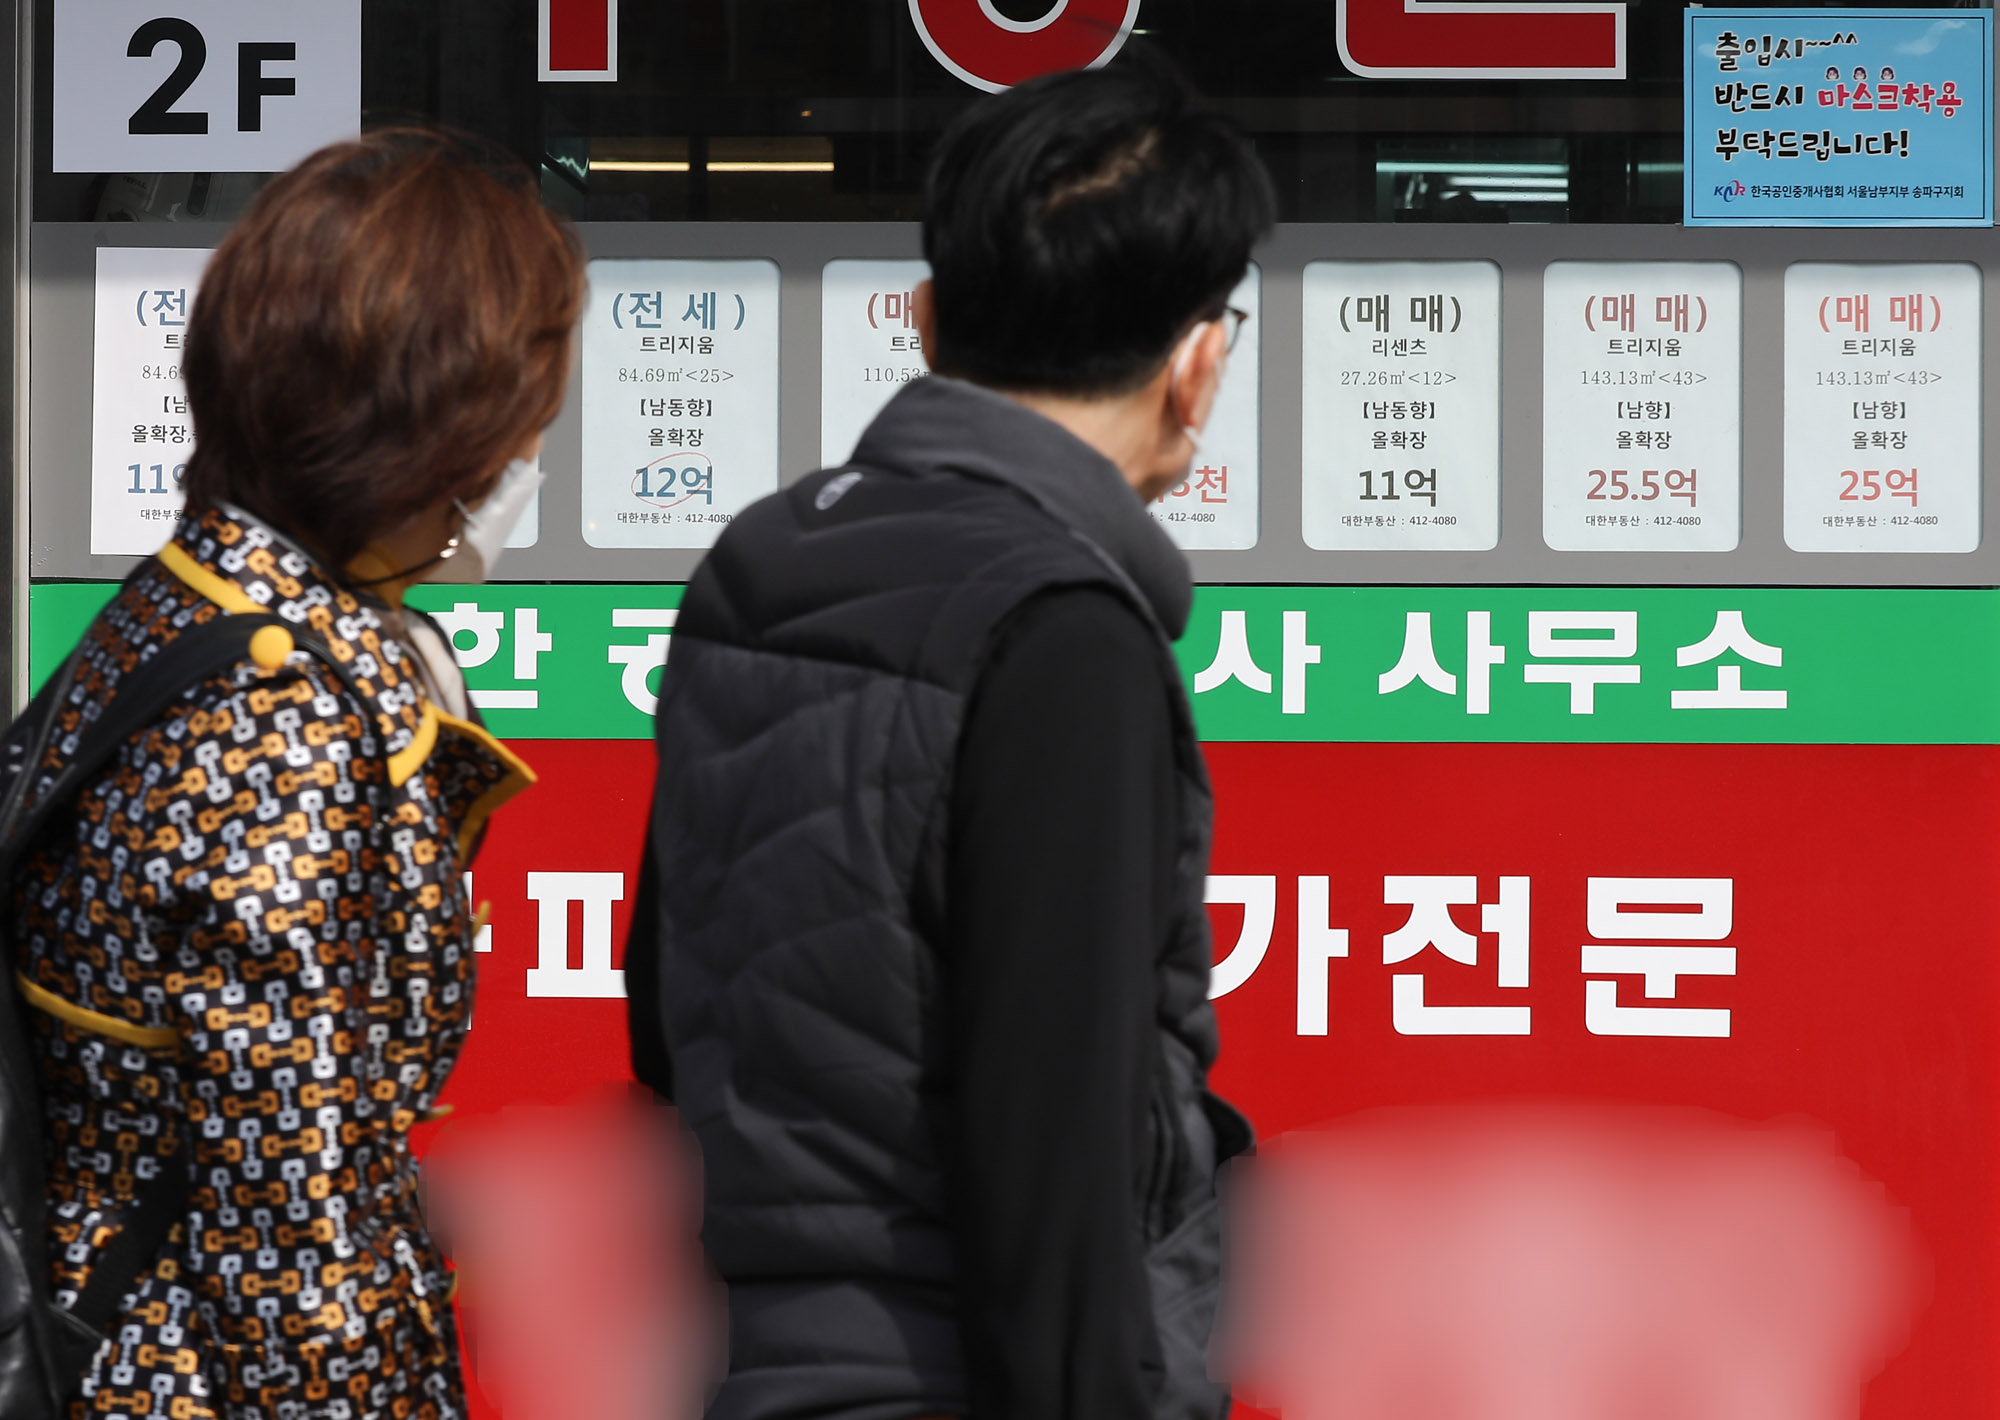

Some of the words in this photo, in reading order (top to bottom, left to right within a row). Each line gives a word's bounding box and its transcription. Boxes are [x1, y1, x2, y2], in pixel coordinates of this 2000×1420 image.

[126, 17, 296, 134] 2F
[1715, 83, 1804, 113] 반드시
[1818, 82, 1962, 118] 마스크착용
[1715, 128, 1909, 161] 부탁드립니다!
[1751, 185, 1844, 198] 한국공인중개사협회
[1847, 185, 1909, 198] 서울남부지부
[1912, 185, 1964, 198] 송파구지회
[163, 334, 190, 349] 트
[640, 336, 714, 354] 트리지움
[1373, 338, 1427, 357] 리센츠
[1607, 338, 1682, 357] 트리지움
[1842, 338, 1916, 357] 트리지움
[641, 398, 712, 417] 【남동향】
[1364, 401, 1434, 420] 【남동향】
[1617, 401, 1672, 420] 【남향】
[1853, 401, 1905, 420] 【남향】
[131, 425, 197, 444] 올확장,
[648, 428, 704, 447] 올확장
[1371, 431, 1427, 450] 올확장
[1616, 431, 1672, 449] 올확장
[1852, 431, 1908, 449] 올확장
[635, 466, 713, 505] 12억
[1359, 468, 1436, 507] 11억
[1587, 469, 1696, 507] 25.5억
[1840, 468, 1917, 507] 25억
[618, 512, 671, 524] 대한부동산
[685, 513, 733, 524] 412-4080
[1168, 512, 1216, 523] 412-4080
[1342, 516, 1396, 527] 대한부동산
[1409, 516, 1456, 525] 412-4080
[1586, 515, 1640, 527] 대한부동산
[1654, 516, 1701, 525] 412-4080
[1823, 516, 1877, 527] 대한부동산
[1891, 516, 1938, 525] 412-4080
[1378, 610, 1788, 715] 사무소
